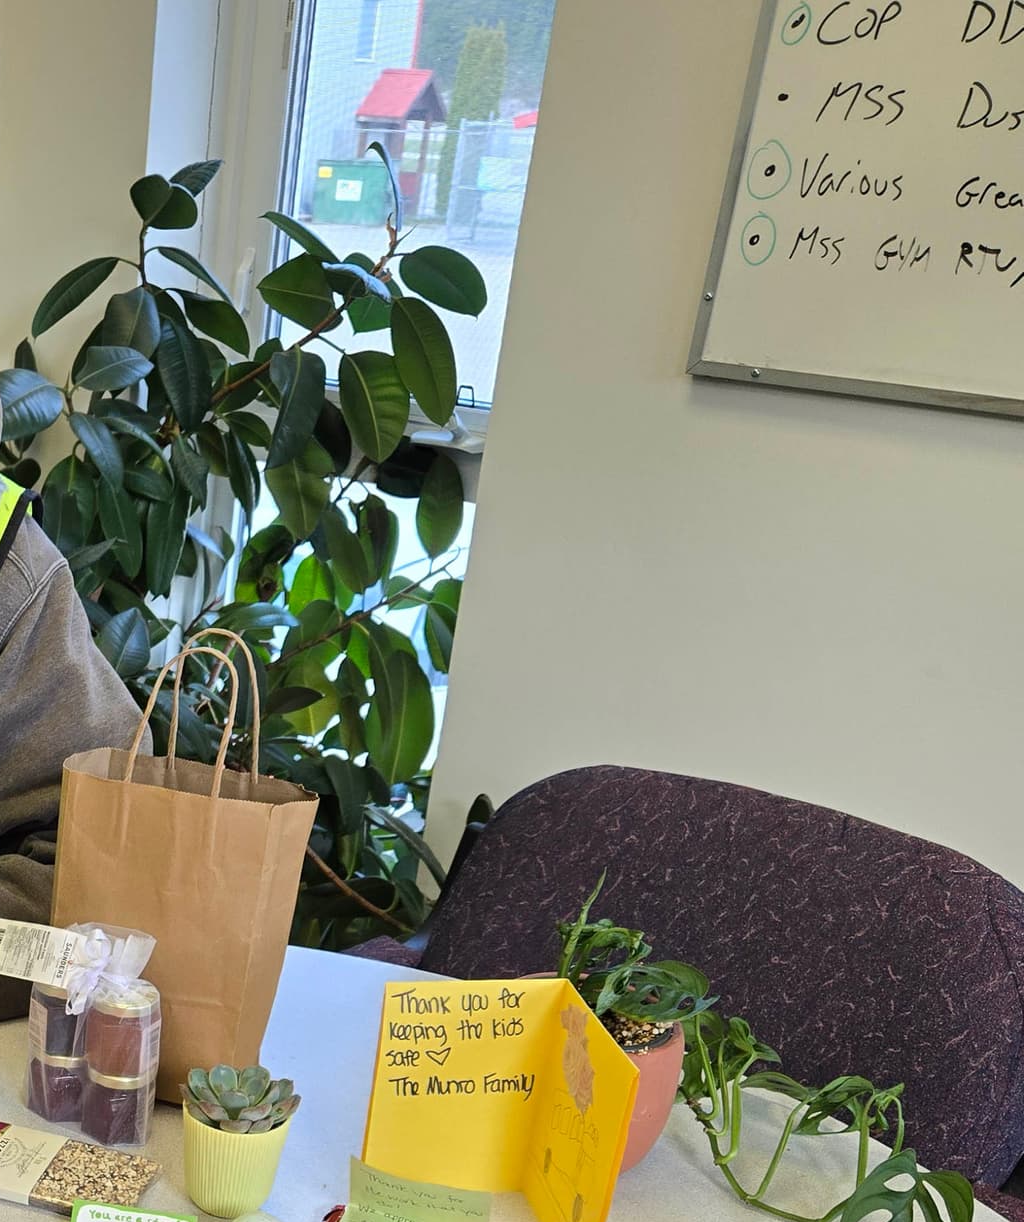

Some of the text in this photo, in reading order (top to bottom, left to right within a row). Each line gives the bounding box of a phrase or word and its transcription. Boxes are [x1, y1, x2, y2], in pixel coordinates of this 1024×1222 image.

[800, 152, 904, 201] Various
[56, 941, 73, 979] SAUNDERS
[392, 987, 526, 1015] Thank you for
[456, 1020, 483, 1041] the
[385, 1048, 421, 1068] safe
[388, 1076, 421, 1097] The
[483, 1073, 536, 1102] Family
[89, 1209, 111, 1220] You
[115, 1215, 133, 1222] are
